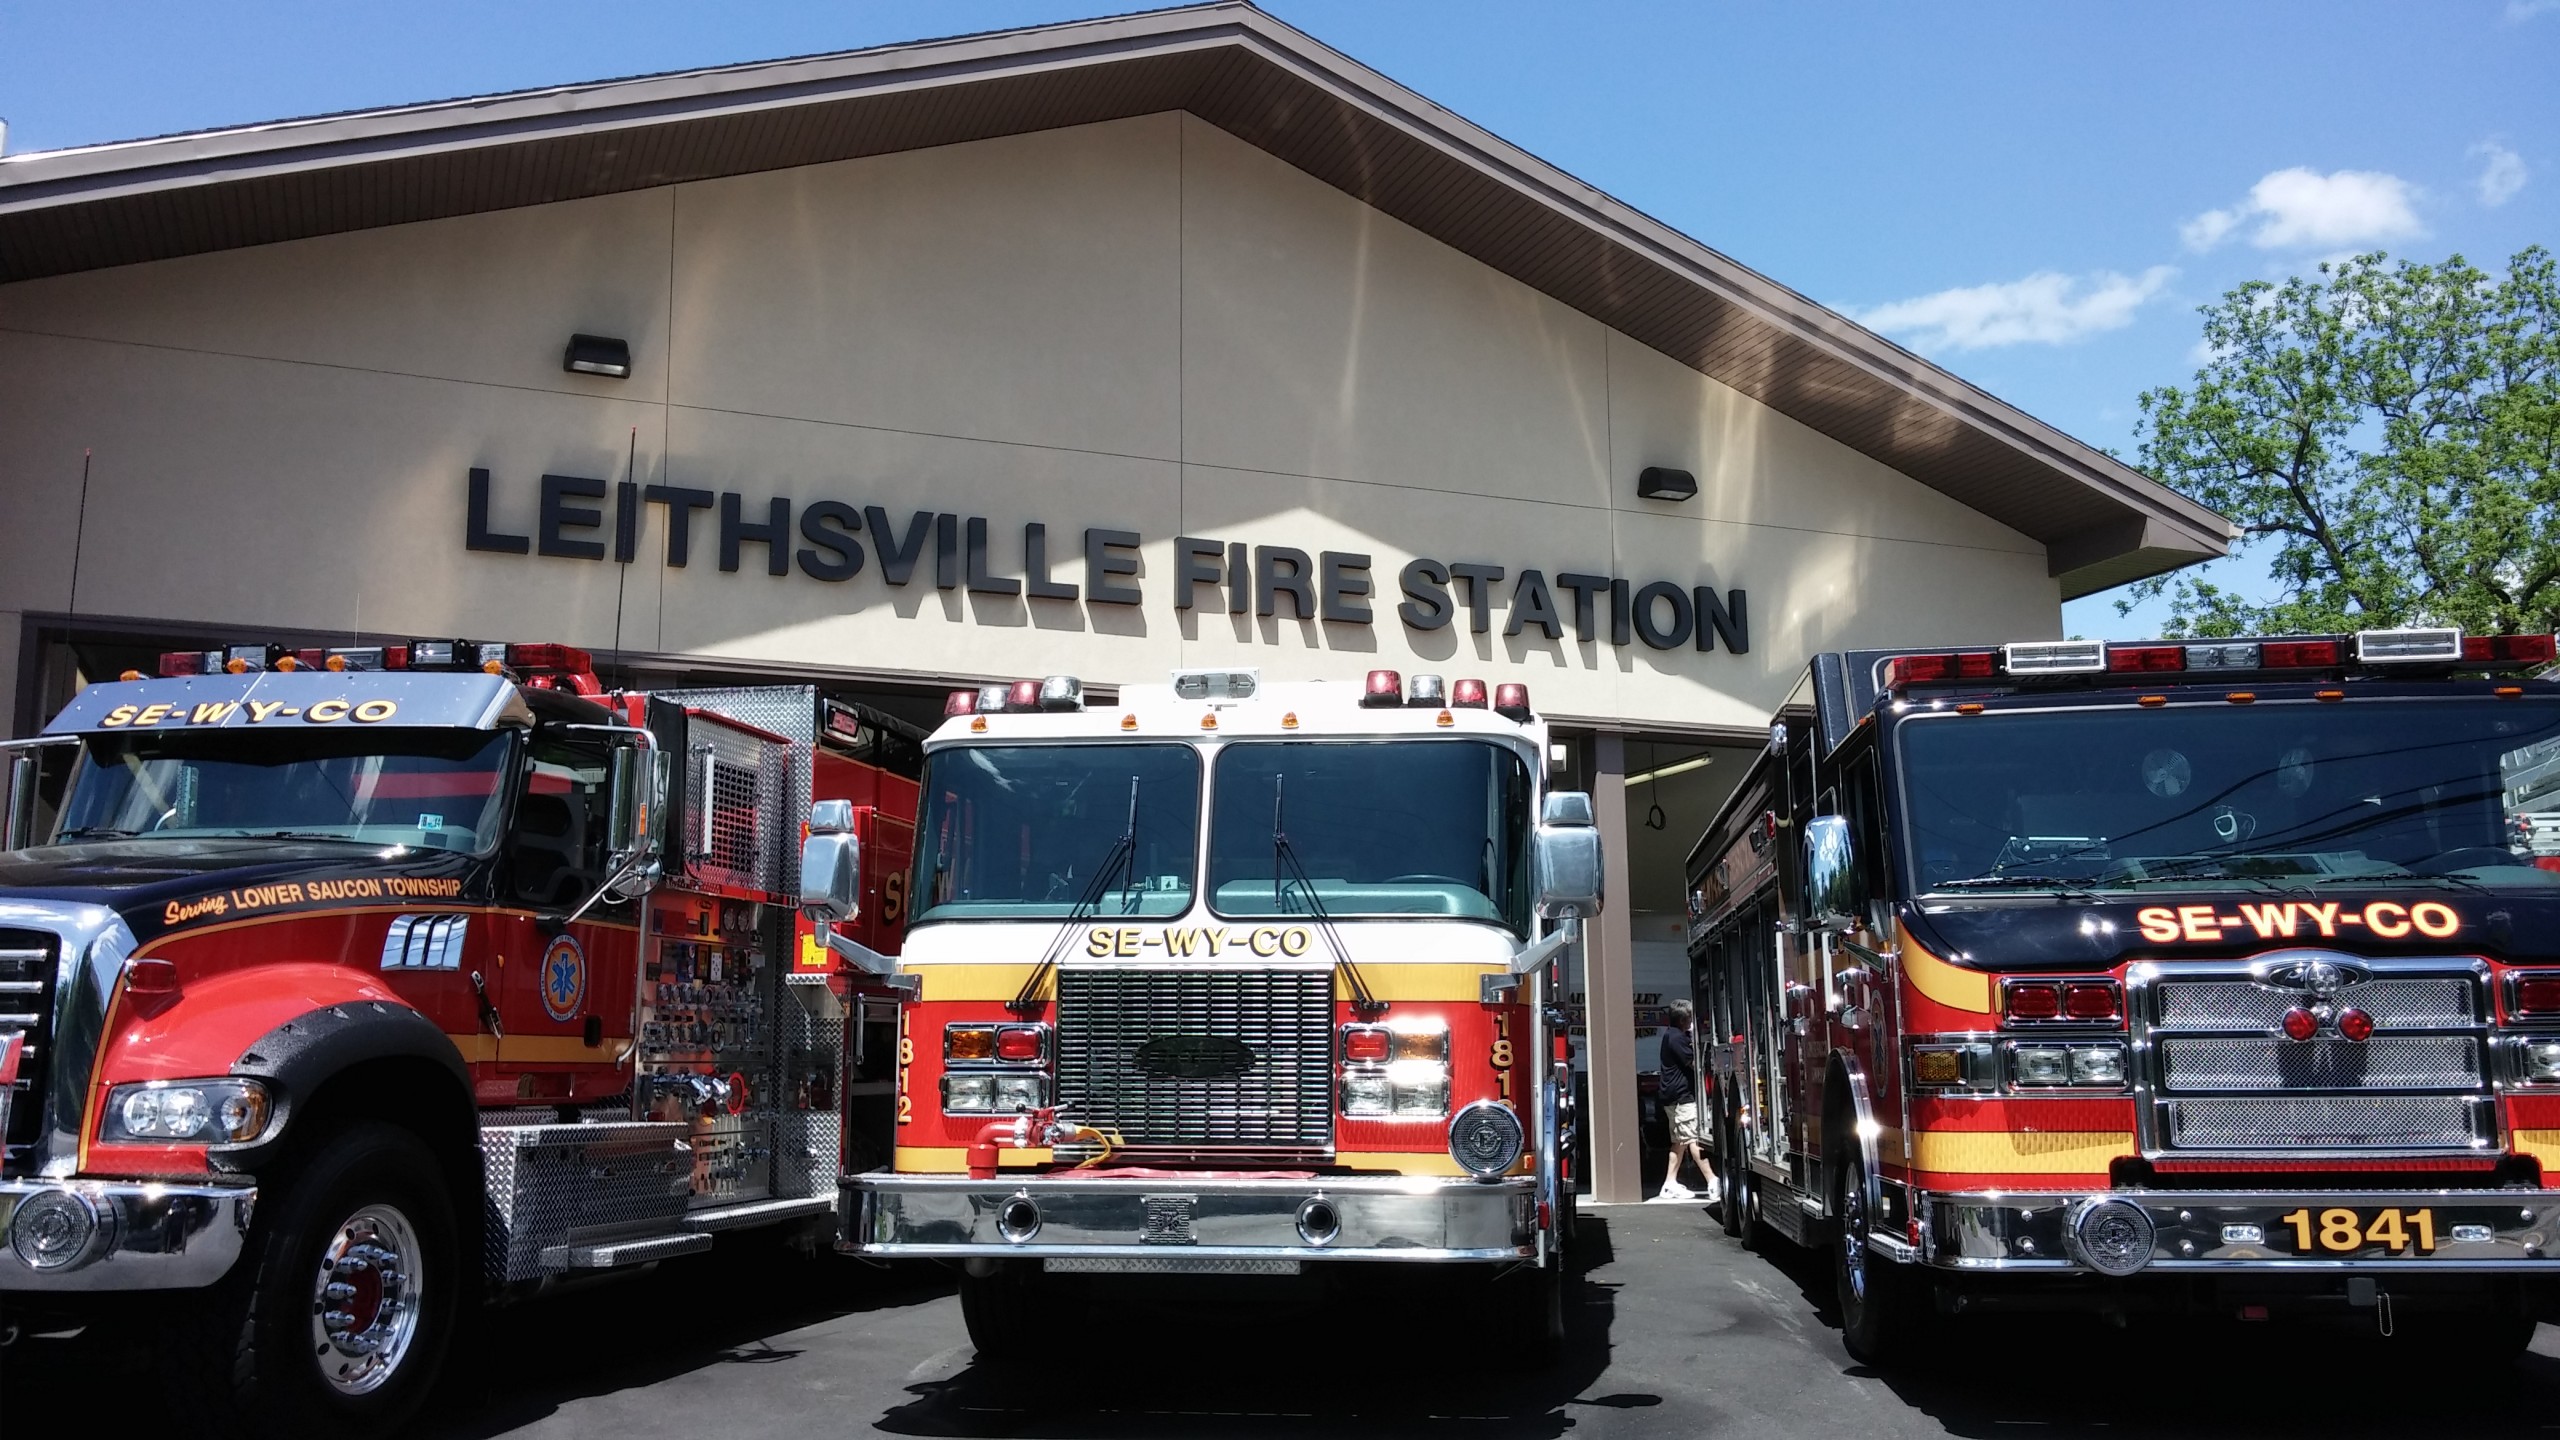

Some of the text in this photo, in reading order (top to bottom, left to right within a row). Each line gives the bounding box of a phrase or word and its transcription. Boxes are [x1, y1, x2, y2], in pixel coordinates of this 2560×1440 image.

[466, 467, 1749, 655] LEITHSVILLE FIRE STATION
[97, 699, 398, 728] SE-WY-CO
[163, 876, 463, 925] Serving LOWER SAUCON TOWNSHIP
[2136, 901, 2460, 943] SE-WY-CO
[1086, 926, 1313, 958] SE-WY-CO
[898, 1009, 914, 1124] 1812
[2282, 1207, 2437, 1255] 1841
